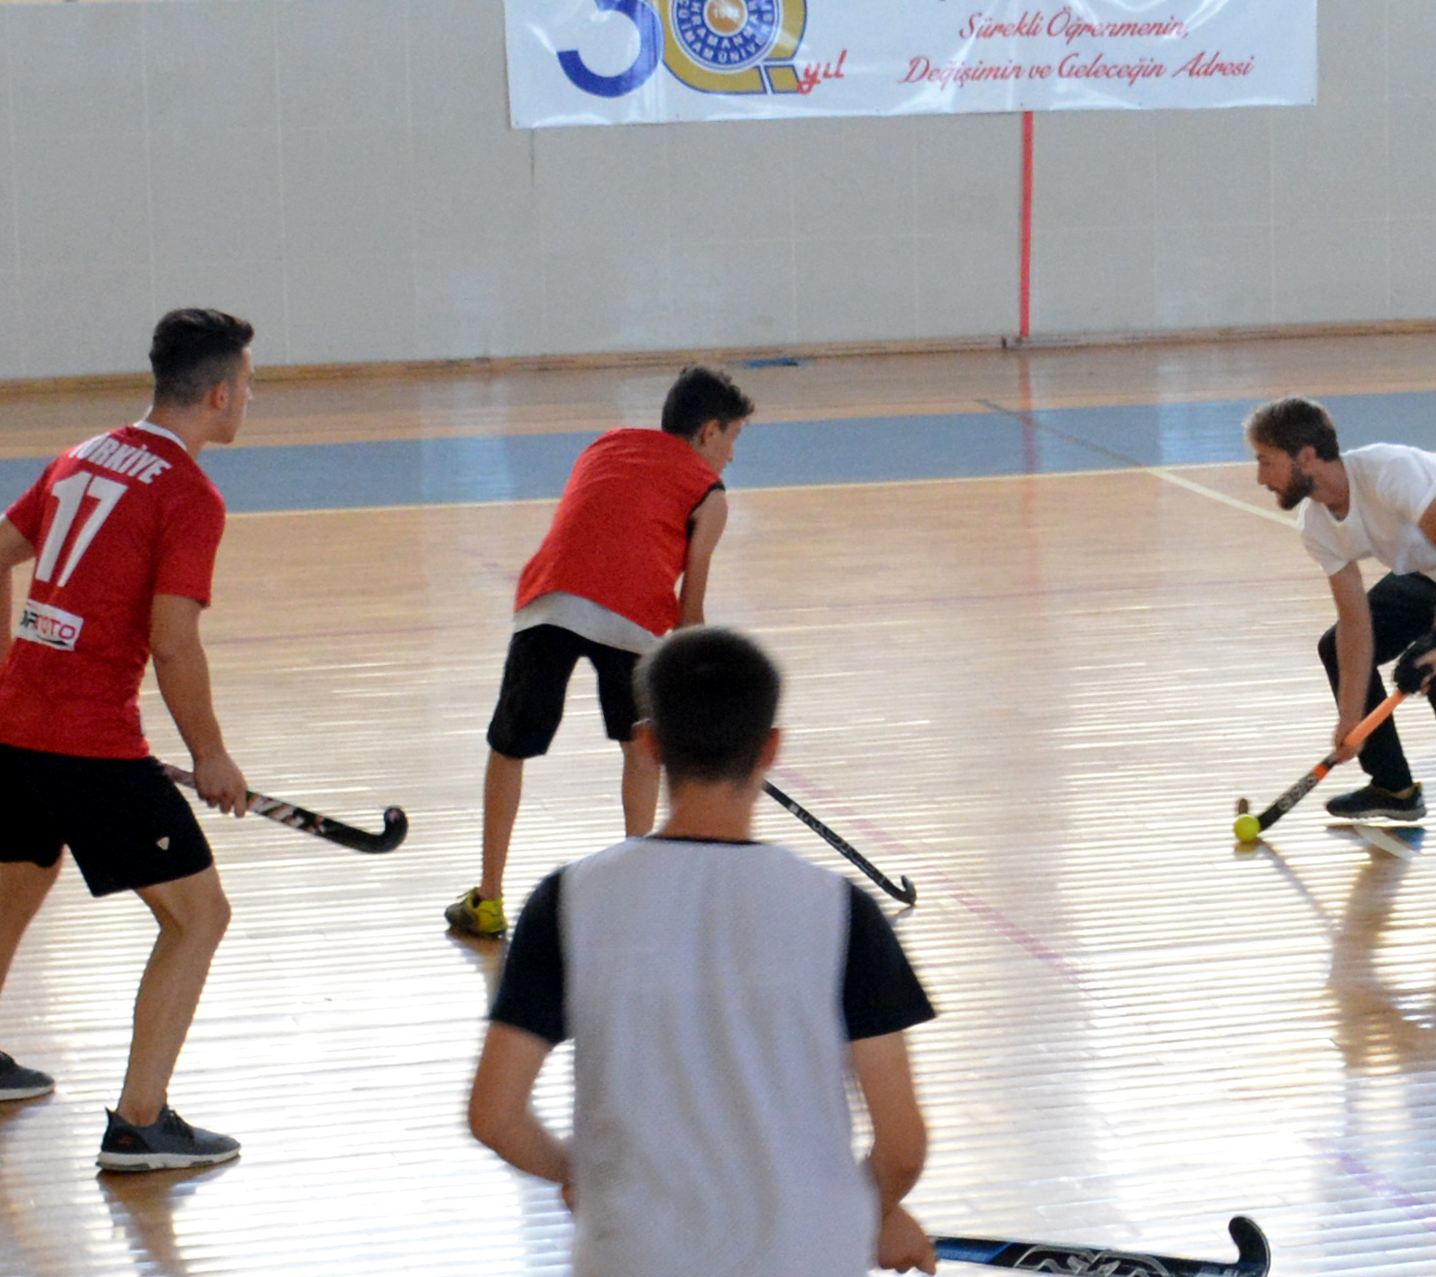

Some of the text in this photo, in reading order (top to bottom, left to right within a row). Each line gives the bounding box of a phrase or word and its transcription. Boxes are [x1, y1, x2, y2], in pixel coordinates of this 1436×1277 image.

[958, 11, 1044, 40] Sürekli
[1028, 64, 1053, 81] ve
[1057, 52, 1167, 87] Geleceğin
[1171, 50, 1255, 79] Adresi
[34, 468, 129, 588] 17
